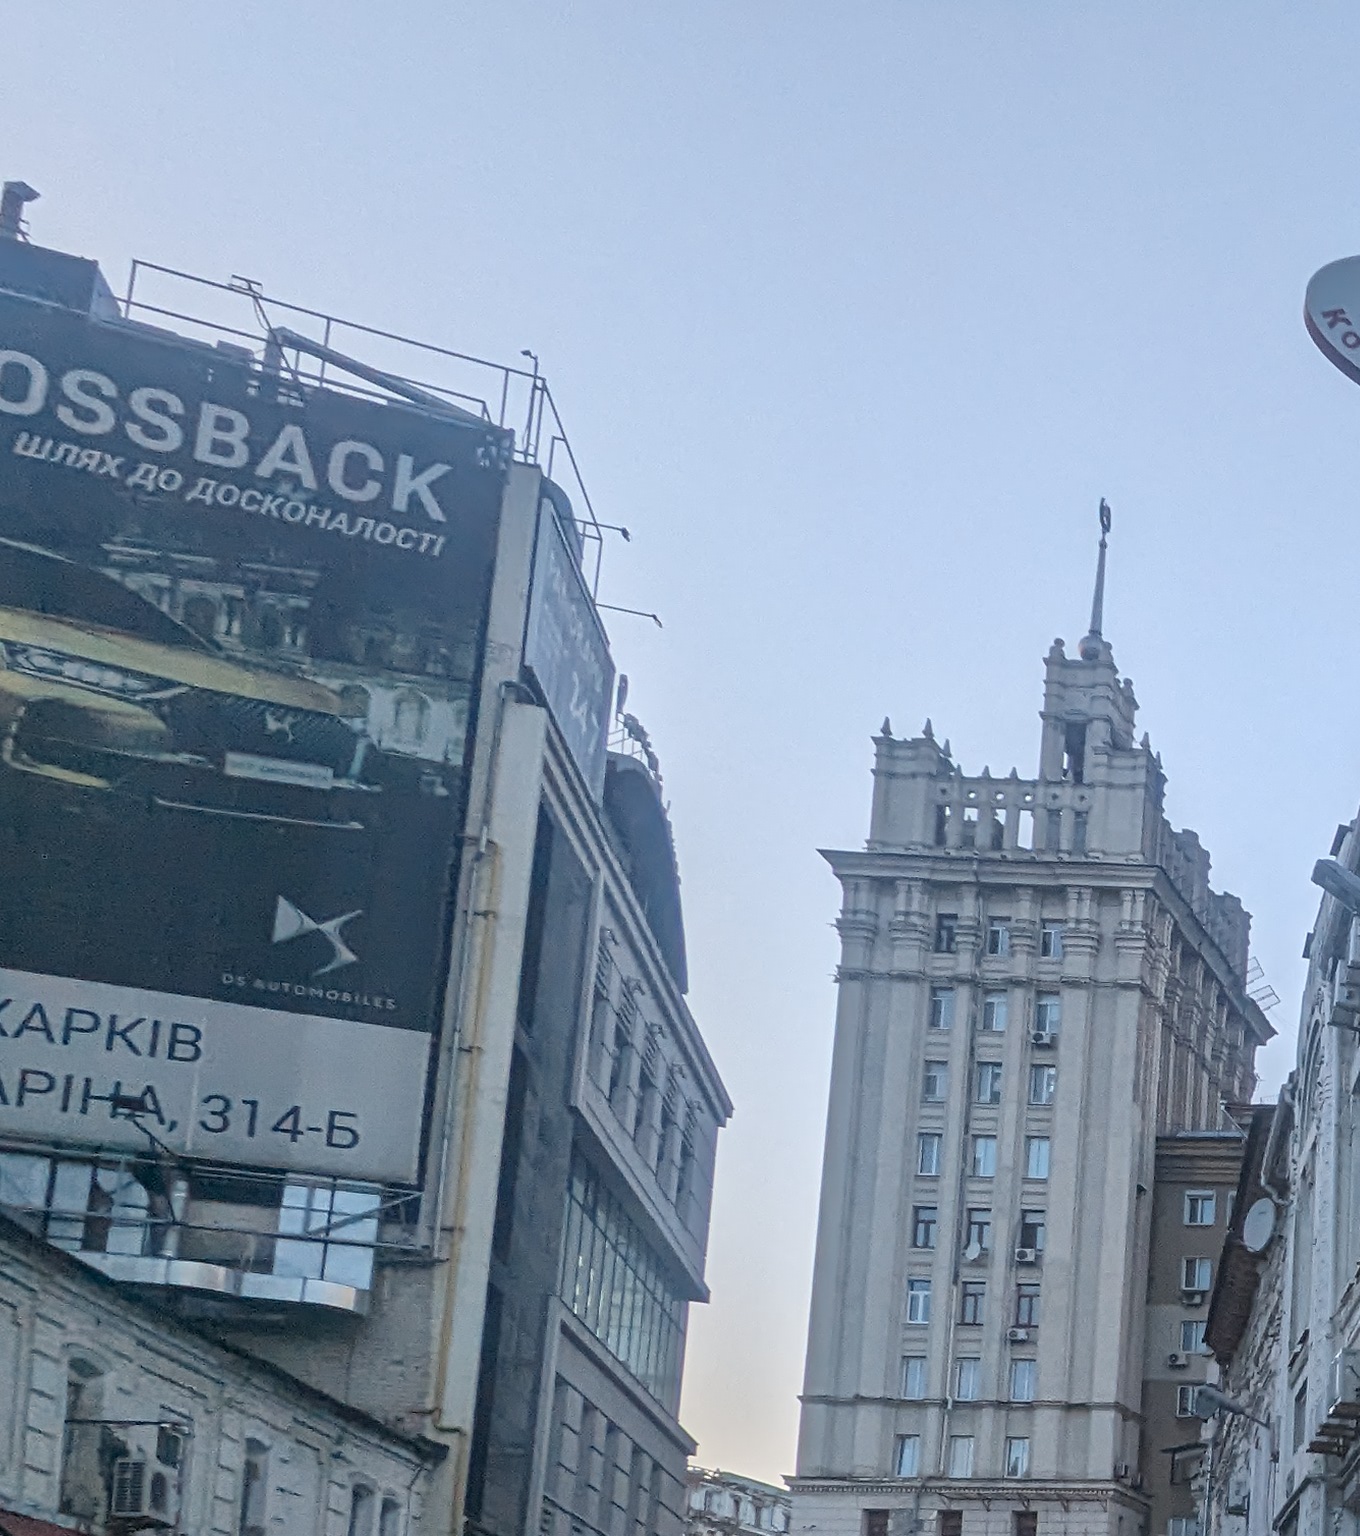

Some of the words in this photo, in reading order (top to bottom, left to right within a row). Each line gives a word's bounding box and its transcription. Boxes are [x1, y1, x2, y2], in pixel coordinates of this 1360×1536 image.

[0, 349, 453, 523] OSSBACK
[13, 431, 125, 478] ШЛЯХ
[125, 462, 183, 492] ДО
[185, 476, 446, 557] ДОСКОНАЛОСТІ
[253, 978, 397, 1011] AUTOMOBILES
[0, 1068, 178, 1133] РІНА,
[200, 1093, 360, 1151] 314-Б
